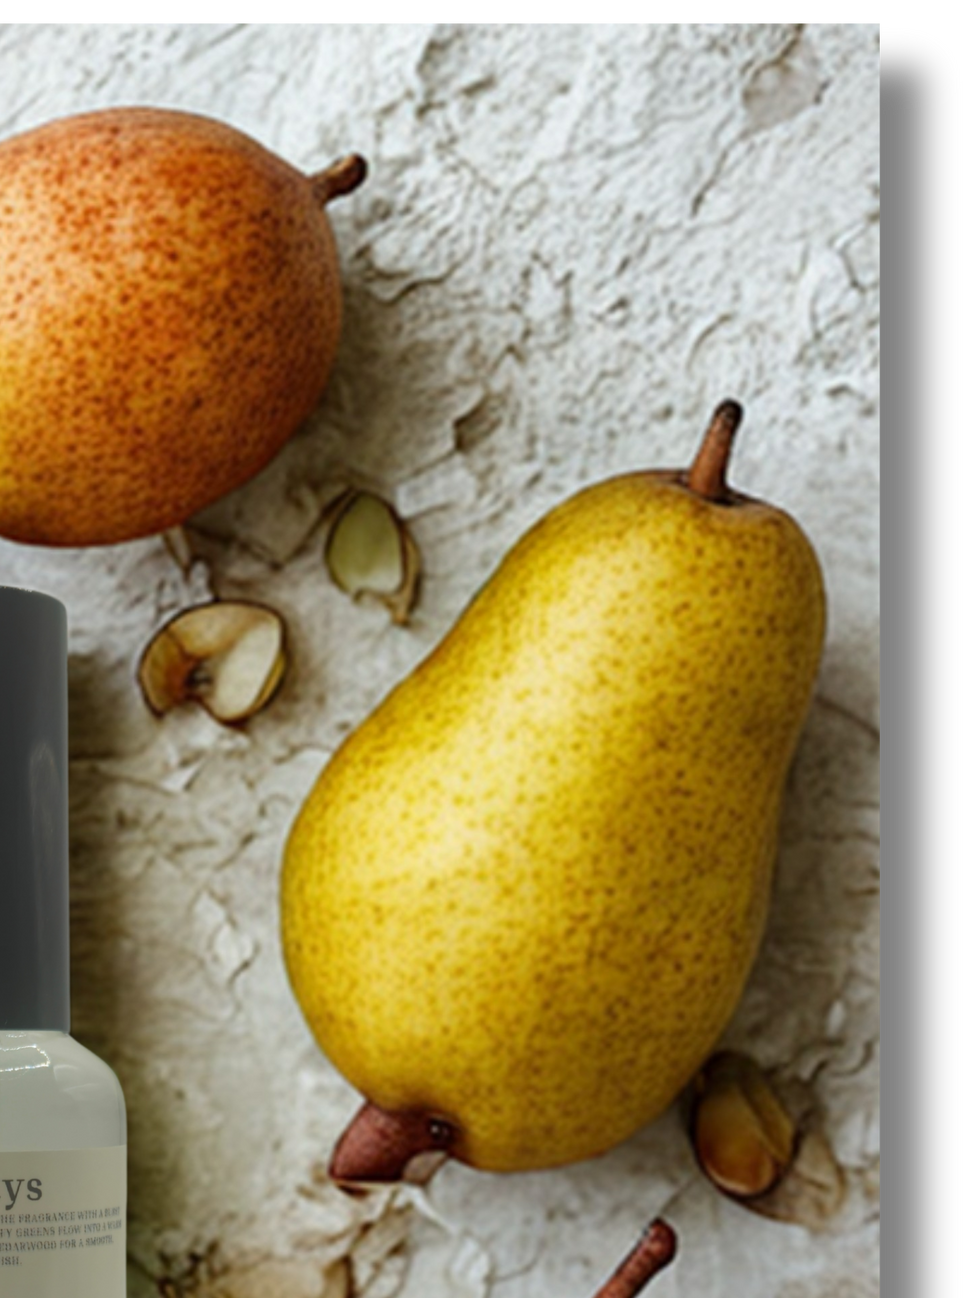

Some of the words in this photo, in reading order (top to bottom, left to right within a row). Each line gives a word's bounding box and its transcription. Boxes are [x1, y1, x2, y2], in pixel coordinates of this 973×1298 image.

[18, 1211, 76, 1224] FRAGRANCE
[78, 1209, 97, 1221] WITH
[16, 1226, 55, 1238] GREENS
[58, 1224, 82, 1236] FLOW
[84, 1222, 100, 1234] INTO
[59, 1238, 76, 1250] FOR
[78, 1238, 84, 1248] A
